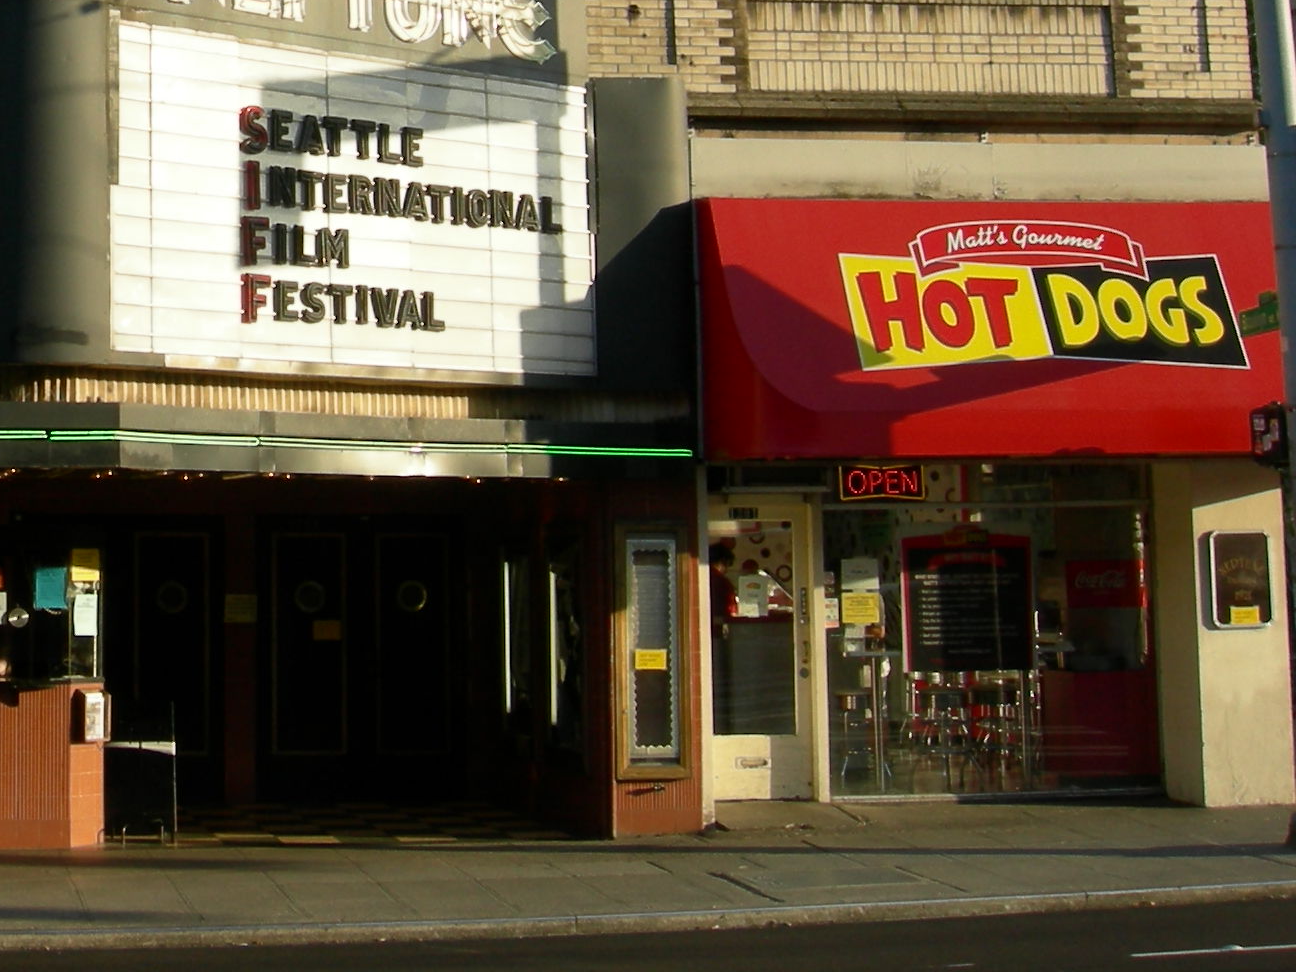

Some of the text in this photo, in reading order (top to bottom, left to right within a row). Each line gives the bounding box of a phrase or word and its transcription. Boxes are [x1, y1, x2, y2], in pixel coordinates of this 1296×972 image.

[238, 105, 424, 168] SEATTLE
[244, 160, 564, 235] INTERNATIONAL
[240, 216, 351, 270] FILM
[946, 224, 1105, 254] Matt's Gourmet
[240, 273, 446, 332] FESTIVAL
[856, 269, 1225, 353] HOT DOGS
[847, 470, 918, 495] OPEN
